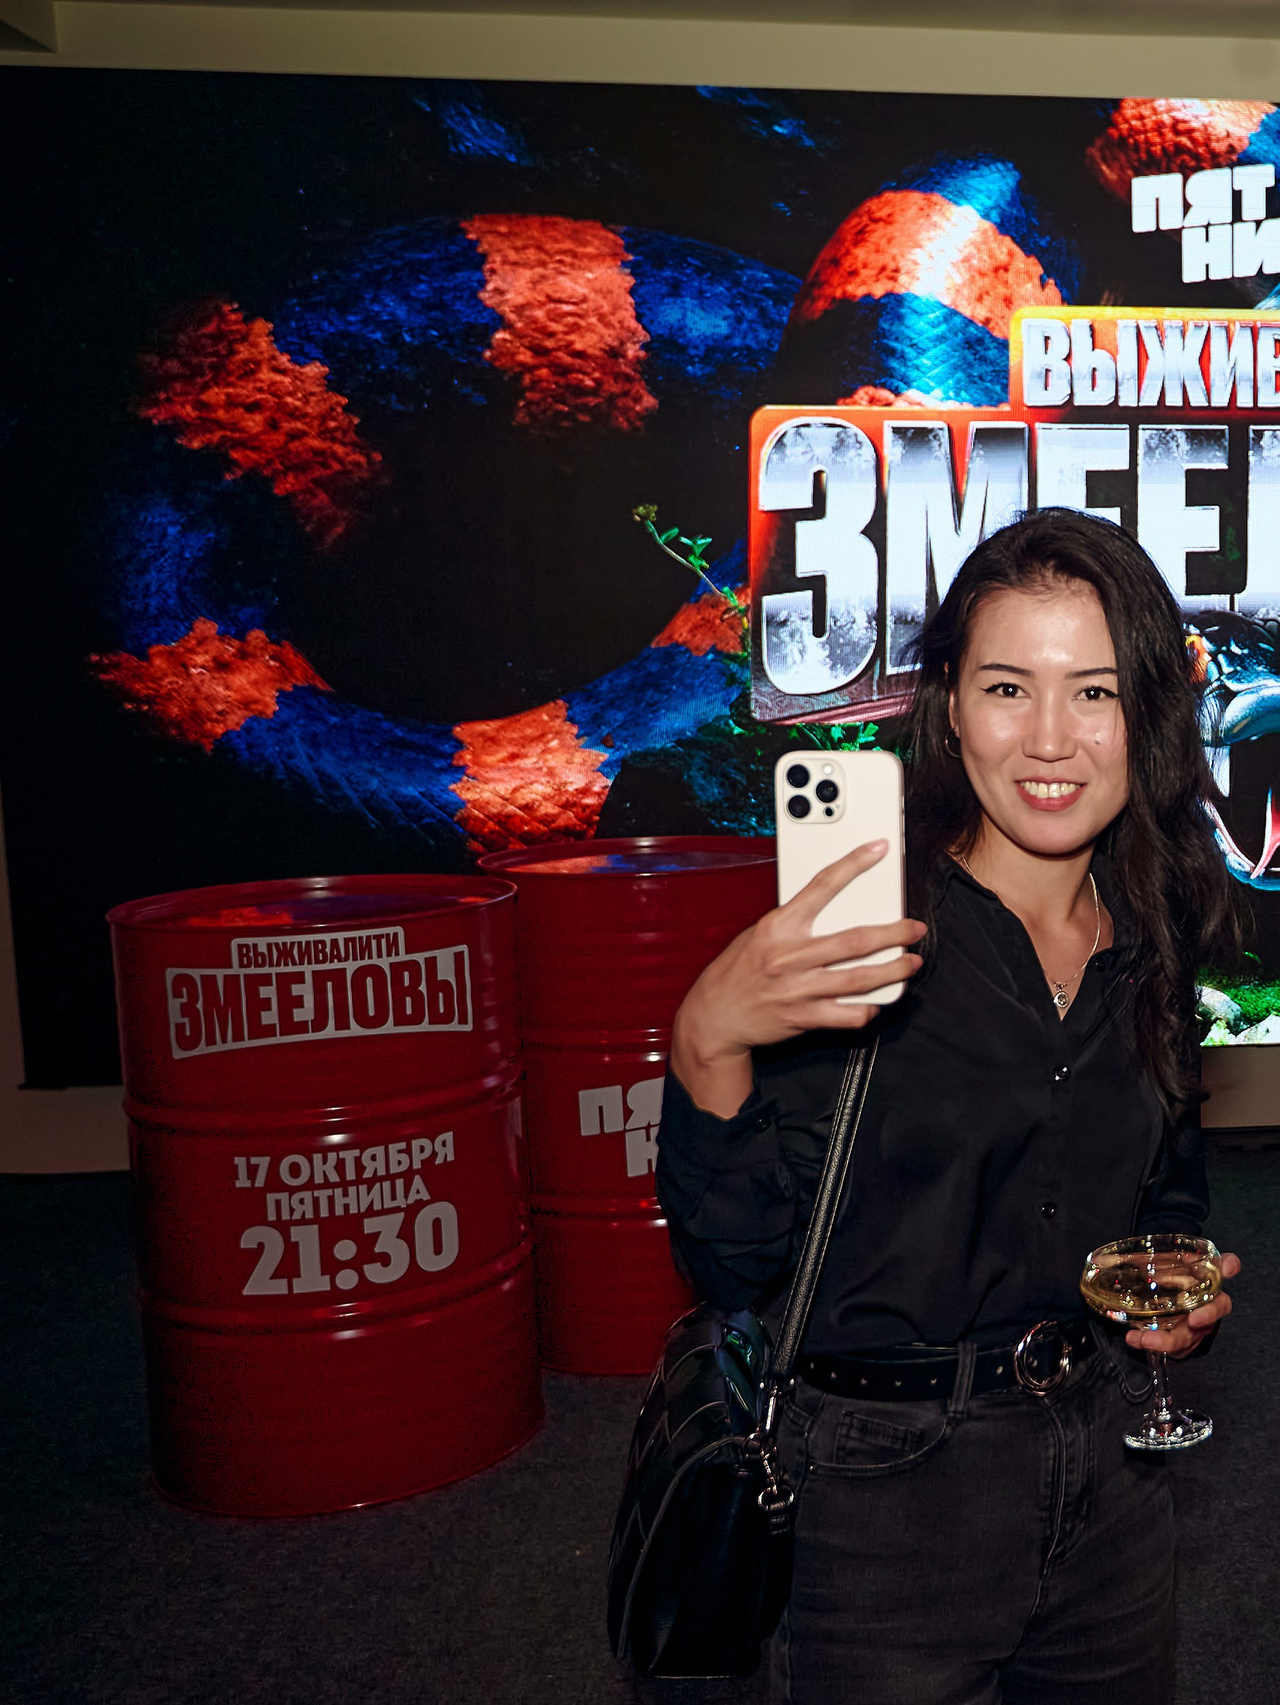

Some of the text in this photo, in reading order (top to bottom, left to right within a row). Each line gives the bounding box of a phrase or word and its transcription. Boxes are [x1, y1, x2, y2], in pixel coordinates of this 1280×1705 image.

[1131, 163, 1276, 233] ПЯТ
[237, 931, 400, 969] ВЫЖИВАЛИТИ
[171, 950, 469, 1051] ЗМЕЕЛОВЫ
[578, 1076, 666, 1136] ПЯ
[233, 1131, 455, 1188] 17 ОКТЯБРЯ
[266, 1174, 431, 1222] ПЯТНИЦА
[240, 1201, 460, 1296] 21:30
